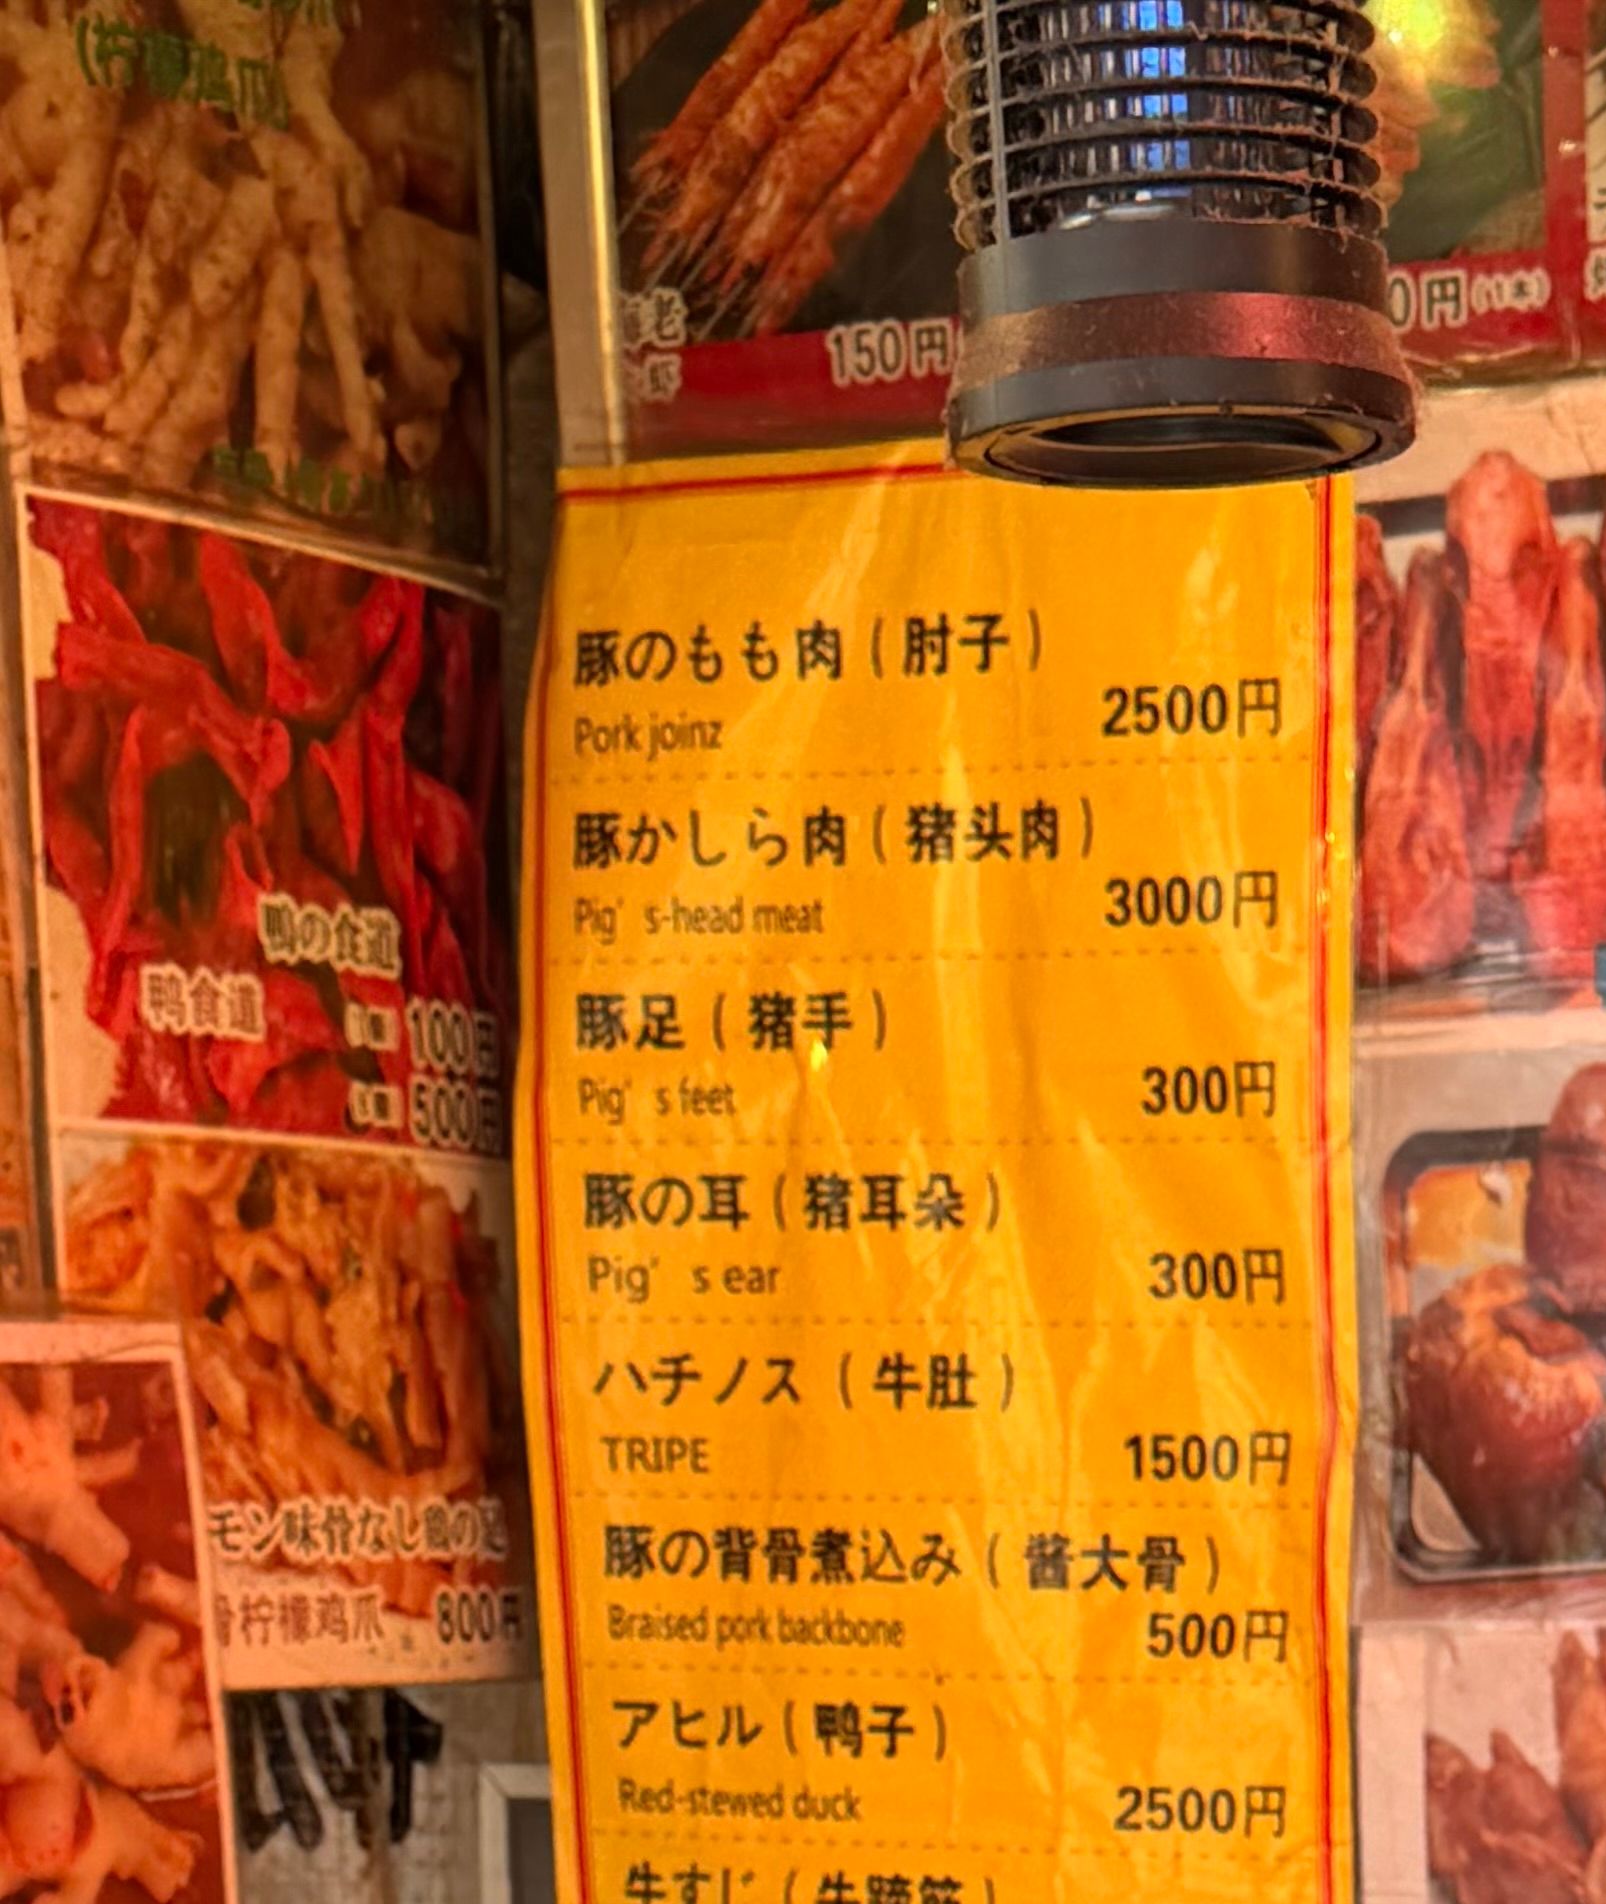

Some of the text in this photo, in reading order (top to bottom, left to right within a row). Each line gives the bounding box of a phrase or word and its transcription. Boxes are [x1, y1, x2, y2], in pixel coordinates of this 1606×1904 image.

[830, 322, 951, 384] 150円
[1101, 678, 1281, 737] 2500円
[574, 713, 723, 762] Pork joinz
[644, 897, 743, 934] s-head
[753, 900, 823, 934] meat
[1104, 870, 1277, 928] 3000円
[679, 1077, 736, 1116] feet
[1141, 1061, 1275, 1117] 300円
[721, 1265, 780, 1294] ear
[1149, 1248, 1285, 1305] 300円
[600, 1436, 709, 1474] TRIPE
[1124, 1430, 1291, 1486] 1500円
[436, 1592, 523, 1645] 800円
[608, 1604, 904, 1650] Braised pork backbone
[1147, 1610, 1289, 1663] 500円
[618, 1776, 860, 1822] Red-stewed duck
[1114, 1785, 1286, 1838] 2500円
